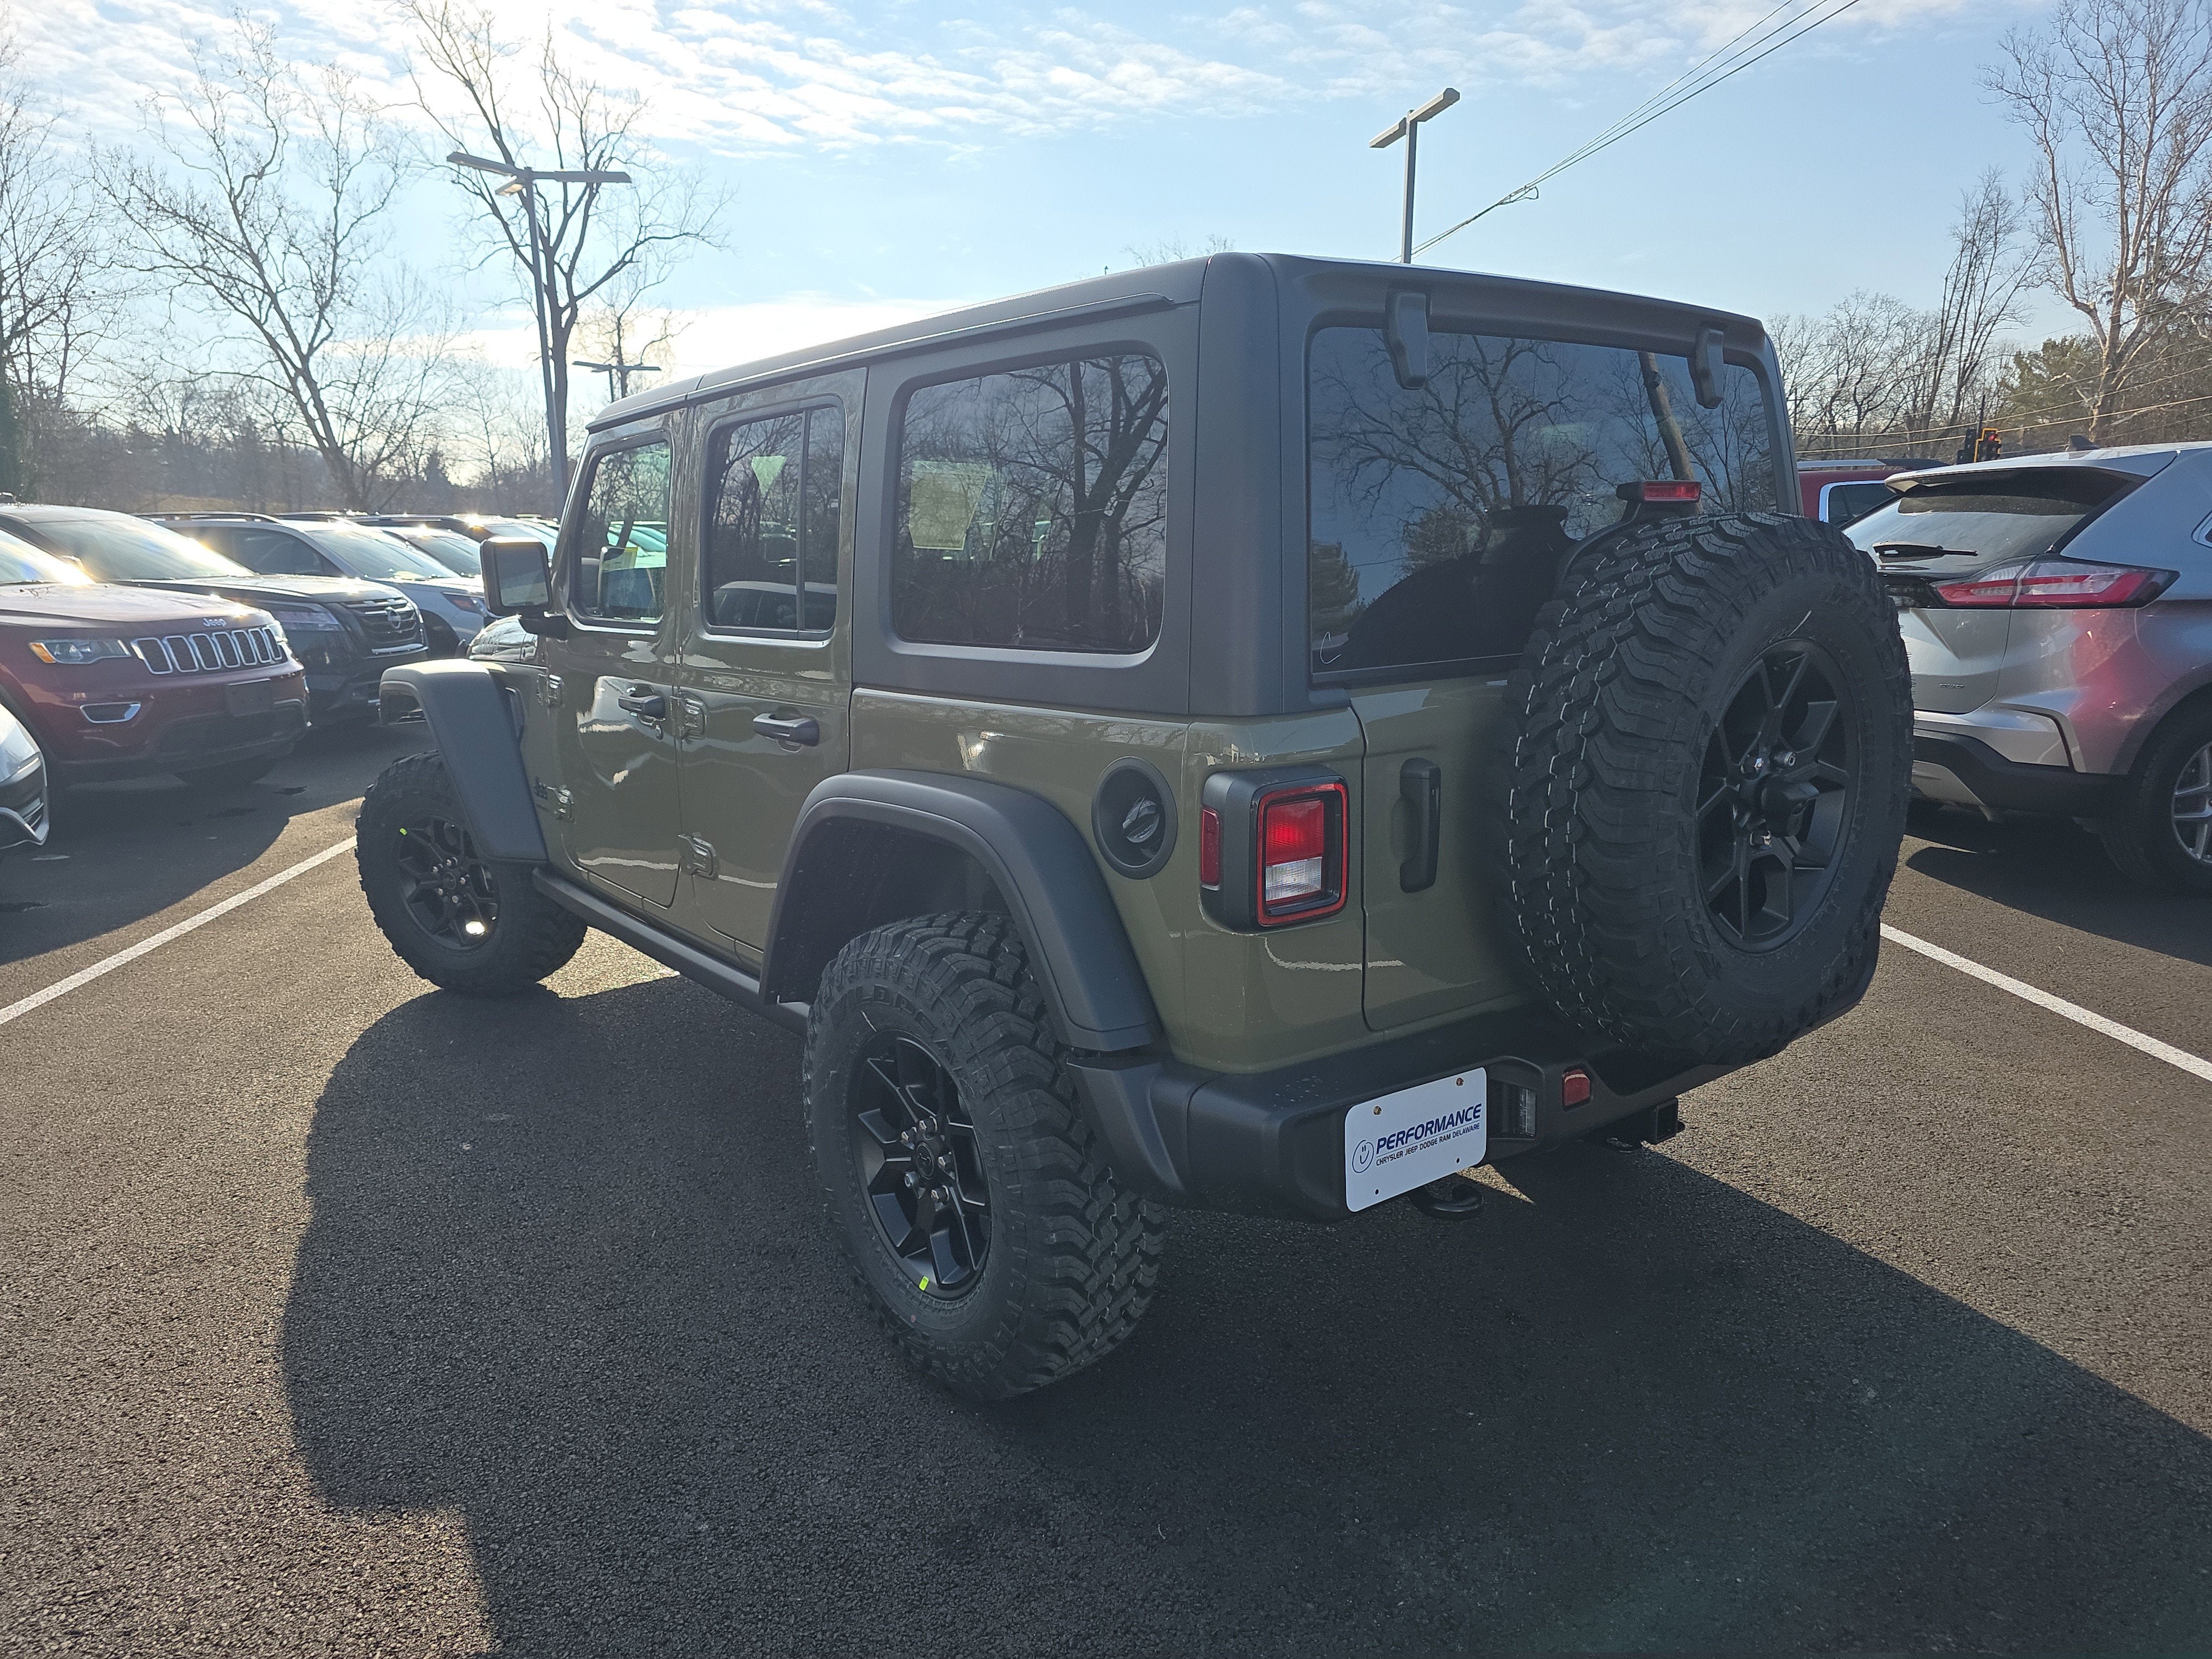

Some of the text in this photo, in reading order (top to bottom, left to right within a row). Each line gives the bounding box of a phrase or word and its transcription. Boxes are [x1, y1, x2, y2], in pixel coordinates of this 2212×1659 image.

[203, 618, 227, 627] Jeep
[1376, 1123, 1480, 1166] CHRYSLER JEEP DODGE RAM DELAWARE
[1377, 1103, 1482, 1154] PERFORMANCE
